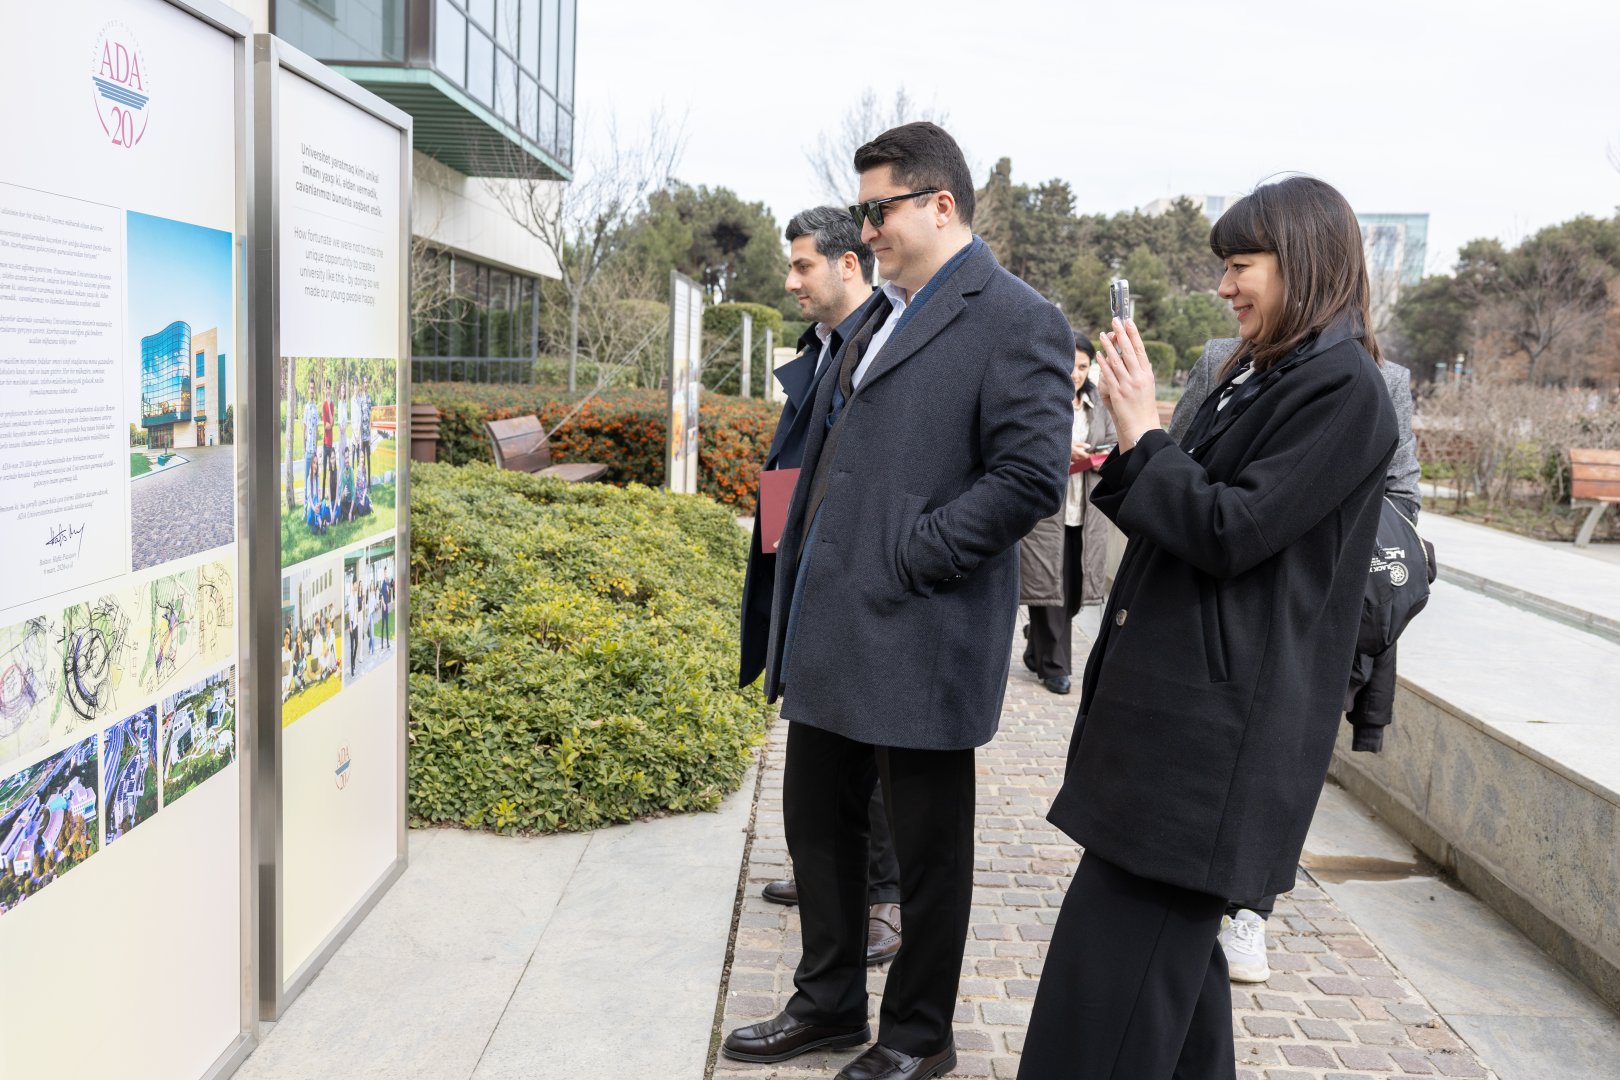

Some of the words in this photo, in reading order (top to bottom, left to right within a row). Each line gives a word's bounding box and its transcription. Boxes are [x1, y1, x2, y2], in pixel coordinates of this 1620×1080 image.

[99, 40, 144, 91] ADA
[111, 106, 133, 148] 20
[301, 142, 330, 165] Universitet
[294, 226, 307, 240] How
[307, 228, 332, 246] fortunate
[332, 239, 340, 248] we
[341, 241, 352, 251] were
[305, 248, 324, 263] unique
[324, 253, 353, 270] opportunity
[359, 261, 372, 272] create
[300, 265, 326, 282] university
[326, 268, 335, 282] like
[335, 271, 345, 283] this
[348, 275, 354, 287] by
[354, 276, 367, 289] doing
[304, 285, 320, 297] made
[320, 288, 329, 298] our
[330, 289, 345, 302] young
[346, 292, 361, 304] people
